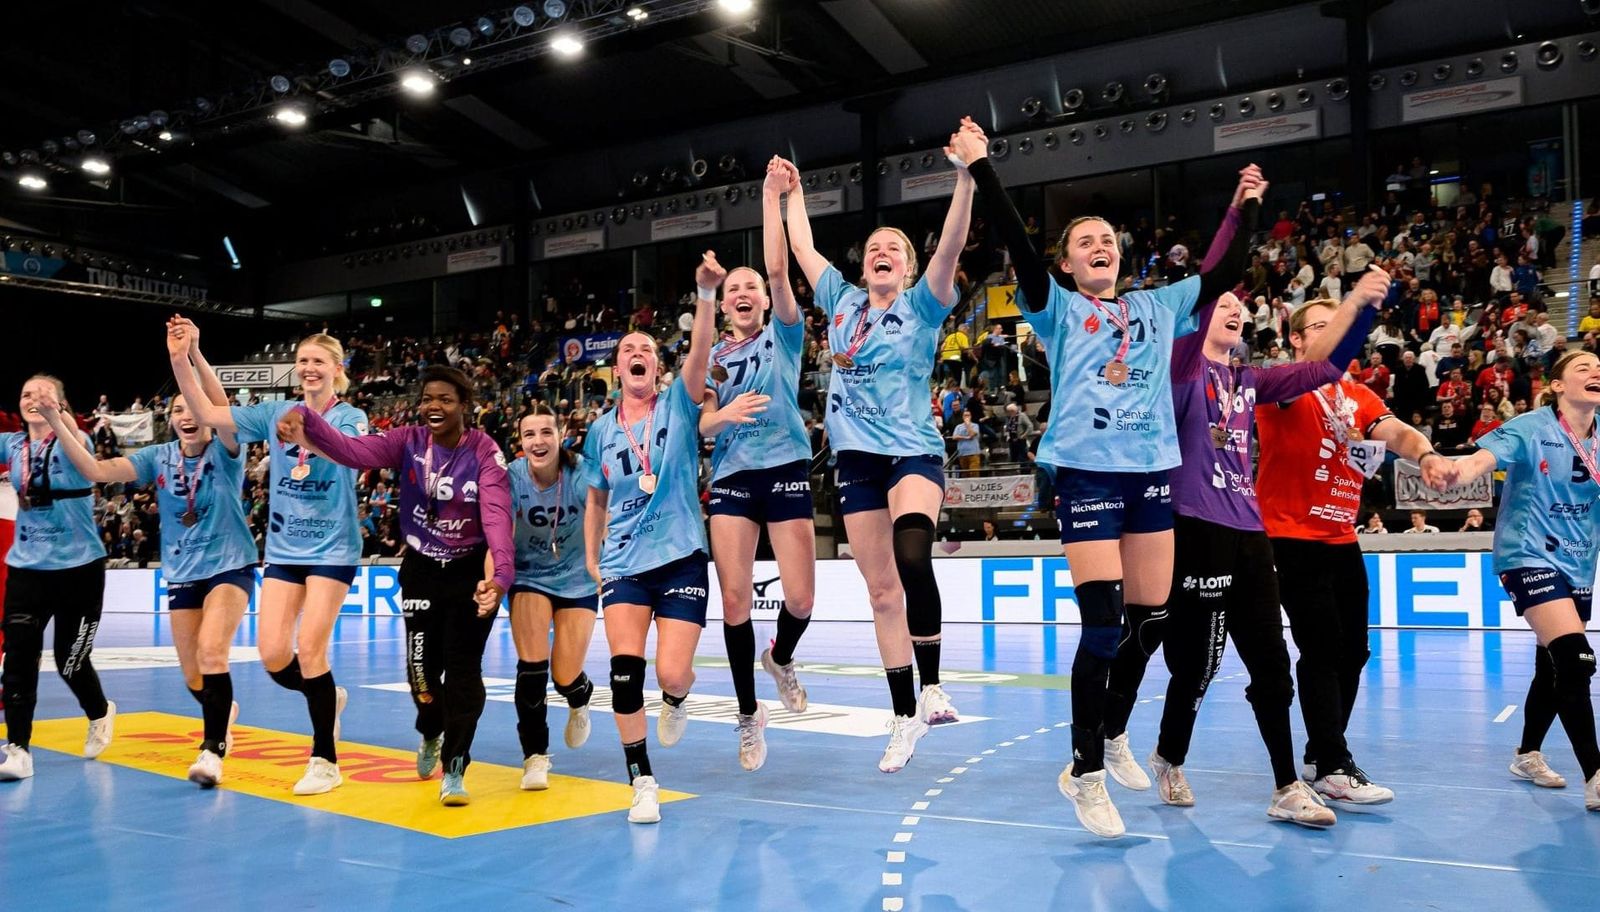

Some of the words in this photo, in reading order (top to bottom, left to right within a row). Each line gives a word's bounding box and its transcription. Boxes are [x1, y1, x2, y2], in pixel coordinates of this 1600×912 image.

[1409, 84, 1488, 102] PORSCHE
[1220, 117, 1288, 133] PORSCHE
[585, 337, 618, 351] Ensin
[220, 370, 269, 382] GEZE
[1117, 420, 1150, 432] Sirona
[731, 489, 750, 499] Koch
[970, 483, 1003, 492] LADIES
[965, 493, 1010, 502] EDELFANS
[1071, 502, 1104, 514] Michael
[1105, 501, 1125, 509] Koch
[288, 514, 337, 530] Dentsply
[1072, 520, 1099, 529] Kempa
[287, 526, 325, 539] Sirona
[1199, 575, 1233, 589] LOTTO
[403, 599, 431, 610] OTTO
[754, 600, 780, 609] IZUN
[1217, 611, 1226, 642] Koch
[414, 632, 425, 660] Koch
